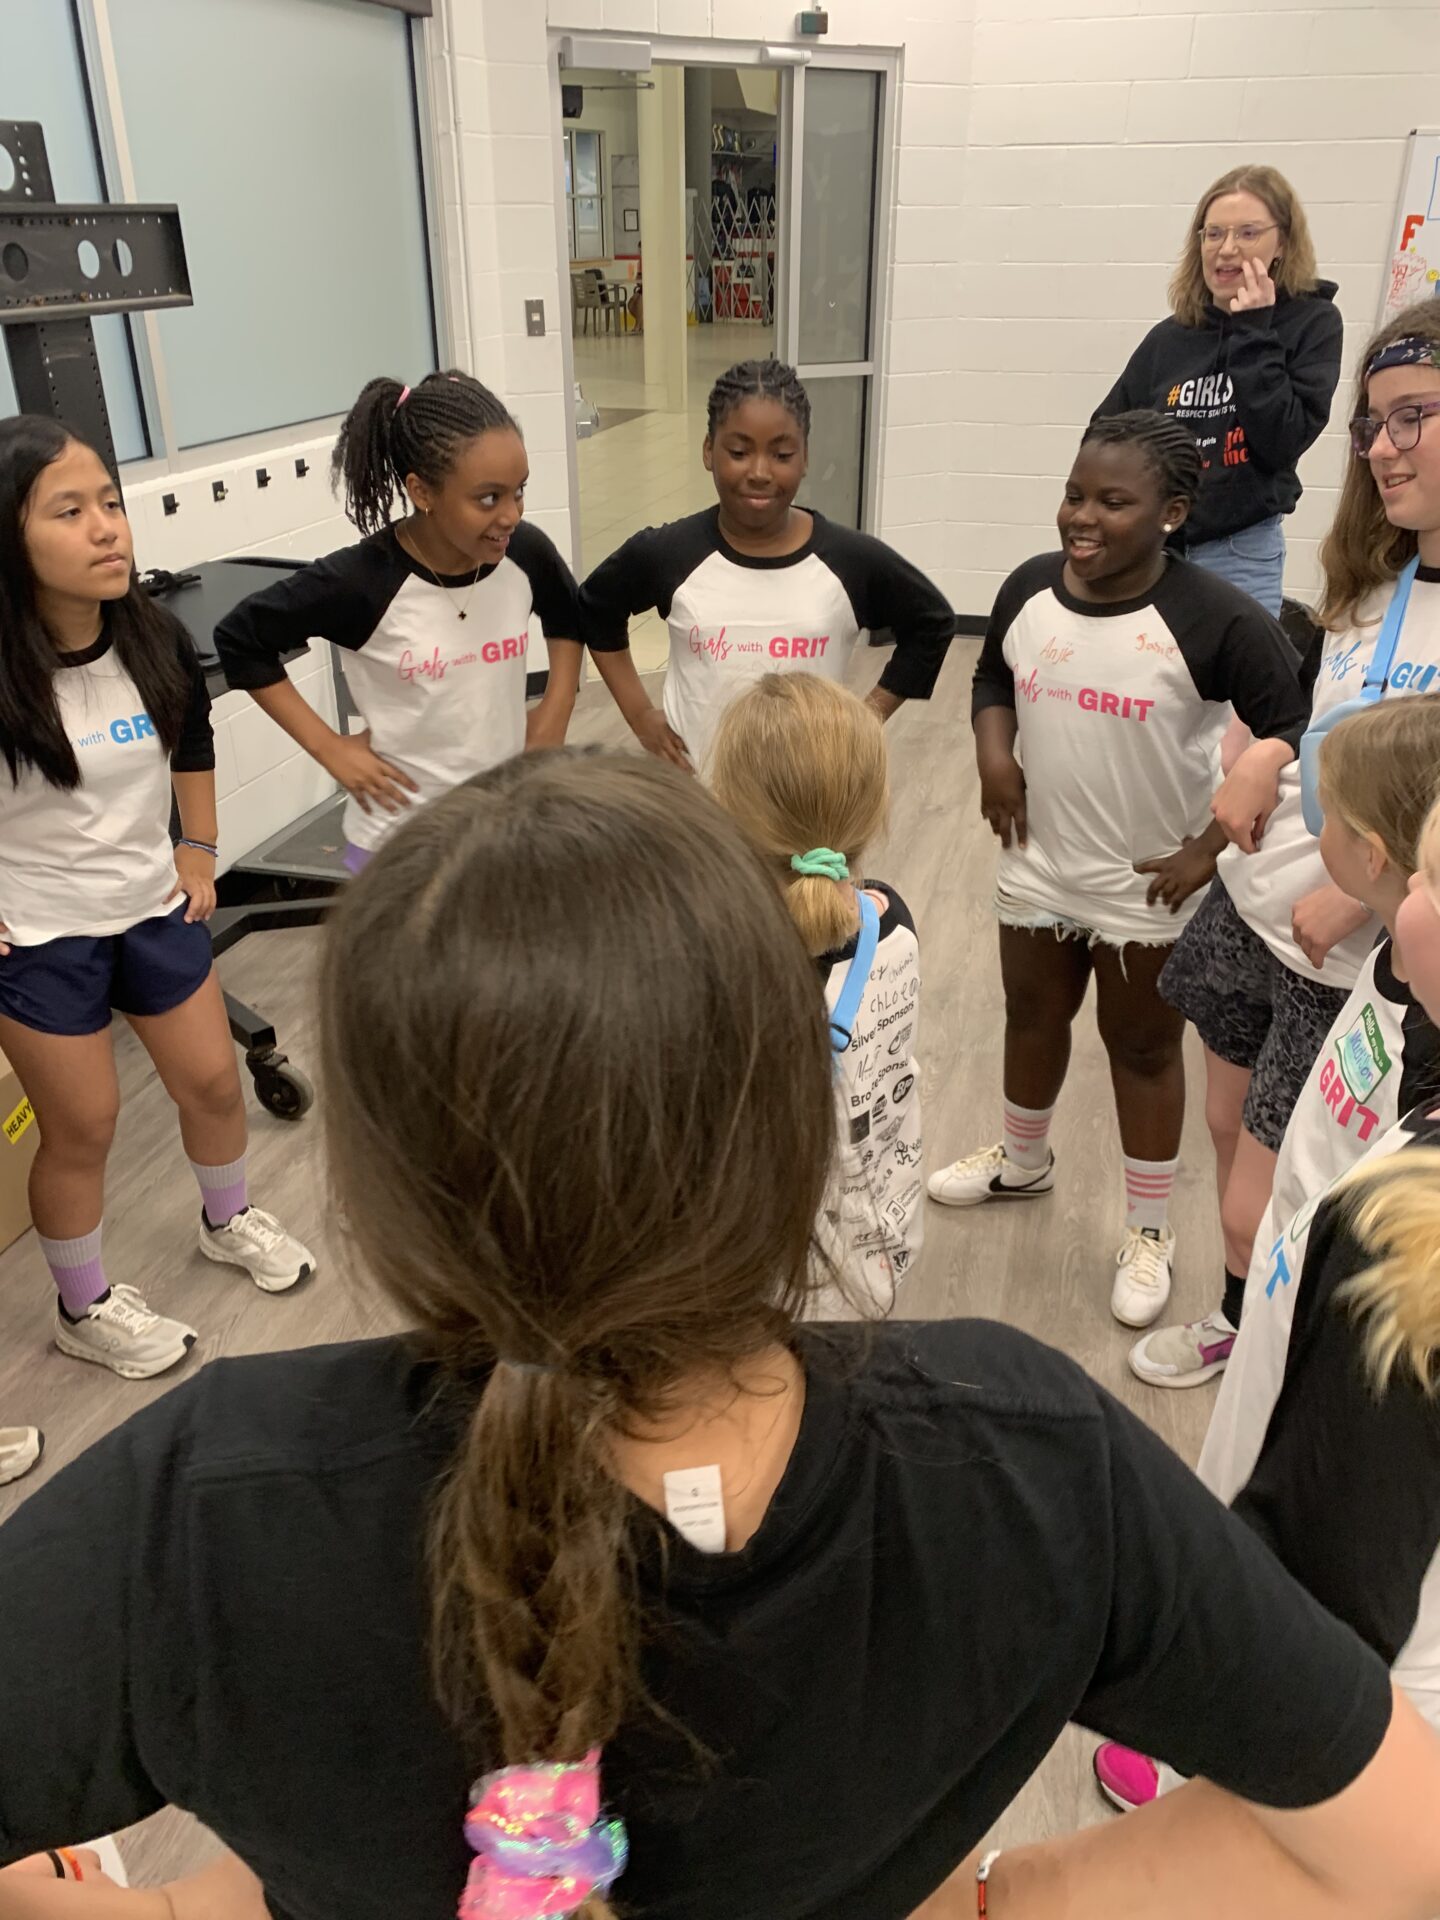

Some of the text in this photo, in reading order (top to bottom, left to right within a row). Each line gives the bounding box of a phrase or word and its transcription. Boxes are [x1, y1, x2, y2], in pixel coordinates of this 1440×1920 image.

[1176, 409, 1207, 418] RESPECT
[689, 624, 830, 662] Girls with GRIT
[398, 646, 448, 685] Girls
[452, 652, 477, 666] with
[1047, 687, 1072, 701] with
[1078, 688, 1155, 722] GRIT
[77, 713, 156, 747] with GR
[1364, 1008, 1374, 1036] Hello
[851, 1078, 879, 1108] Broze
[1319, 1058, 1380, 1142] GRIT
